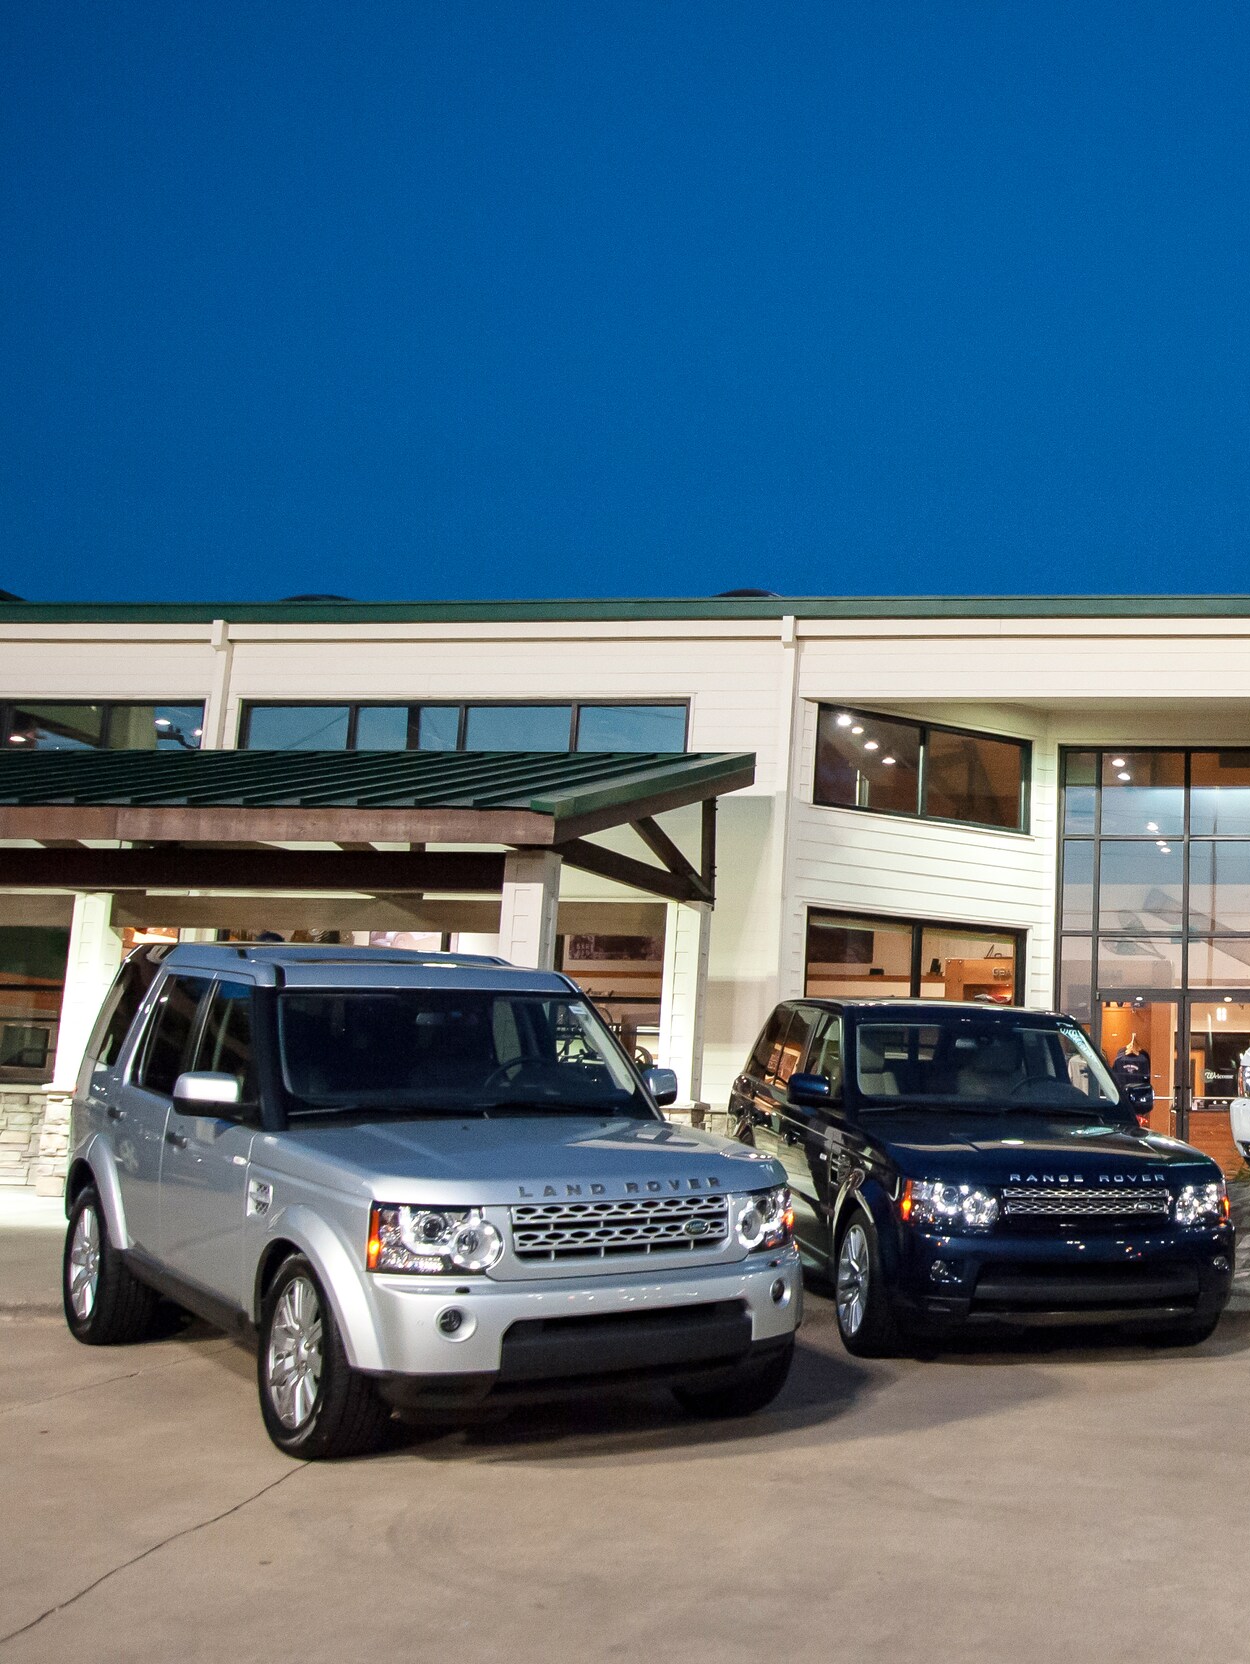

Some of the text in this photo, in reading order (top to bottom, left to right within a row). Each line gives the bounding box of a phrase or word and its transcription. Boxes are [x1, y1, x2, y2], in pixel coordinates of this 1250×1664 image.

[1009, 1173, 1165, 1183] RANGE ROVER
[518, 1176, 721, 1198] LAND ROVER
